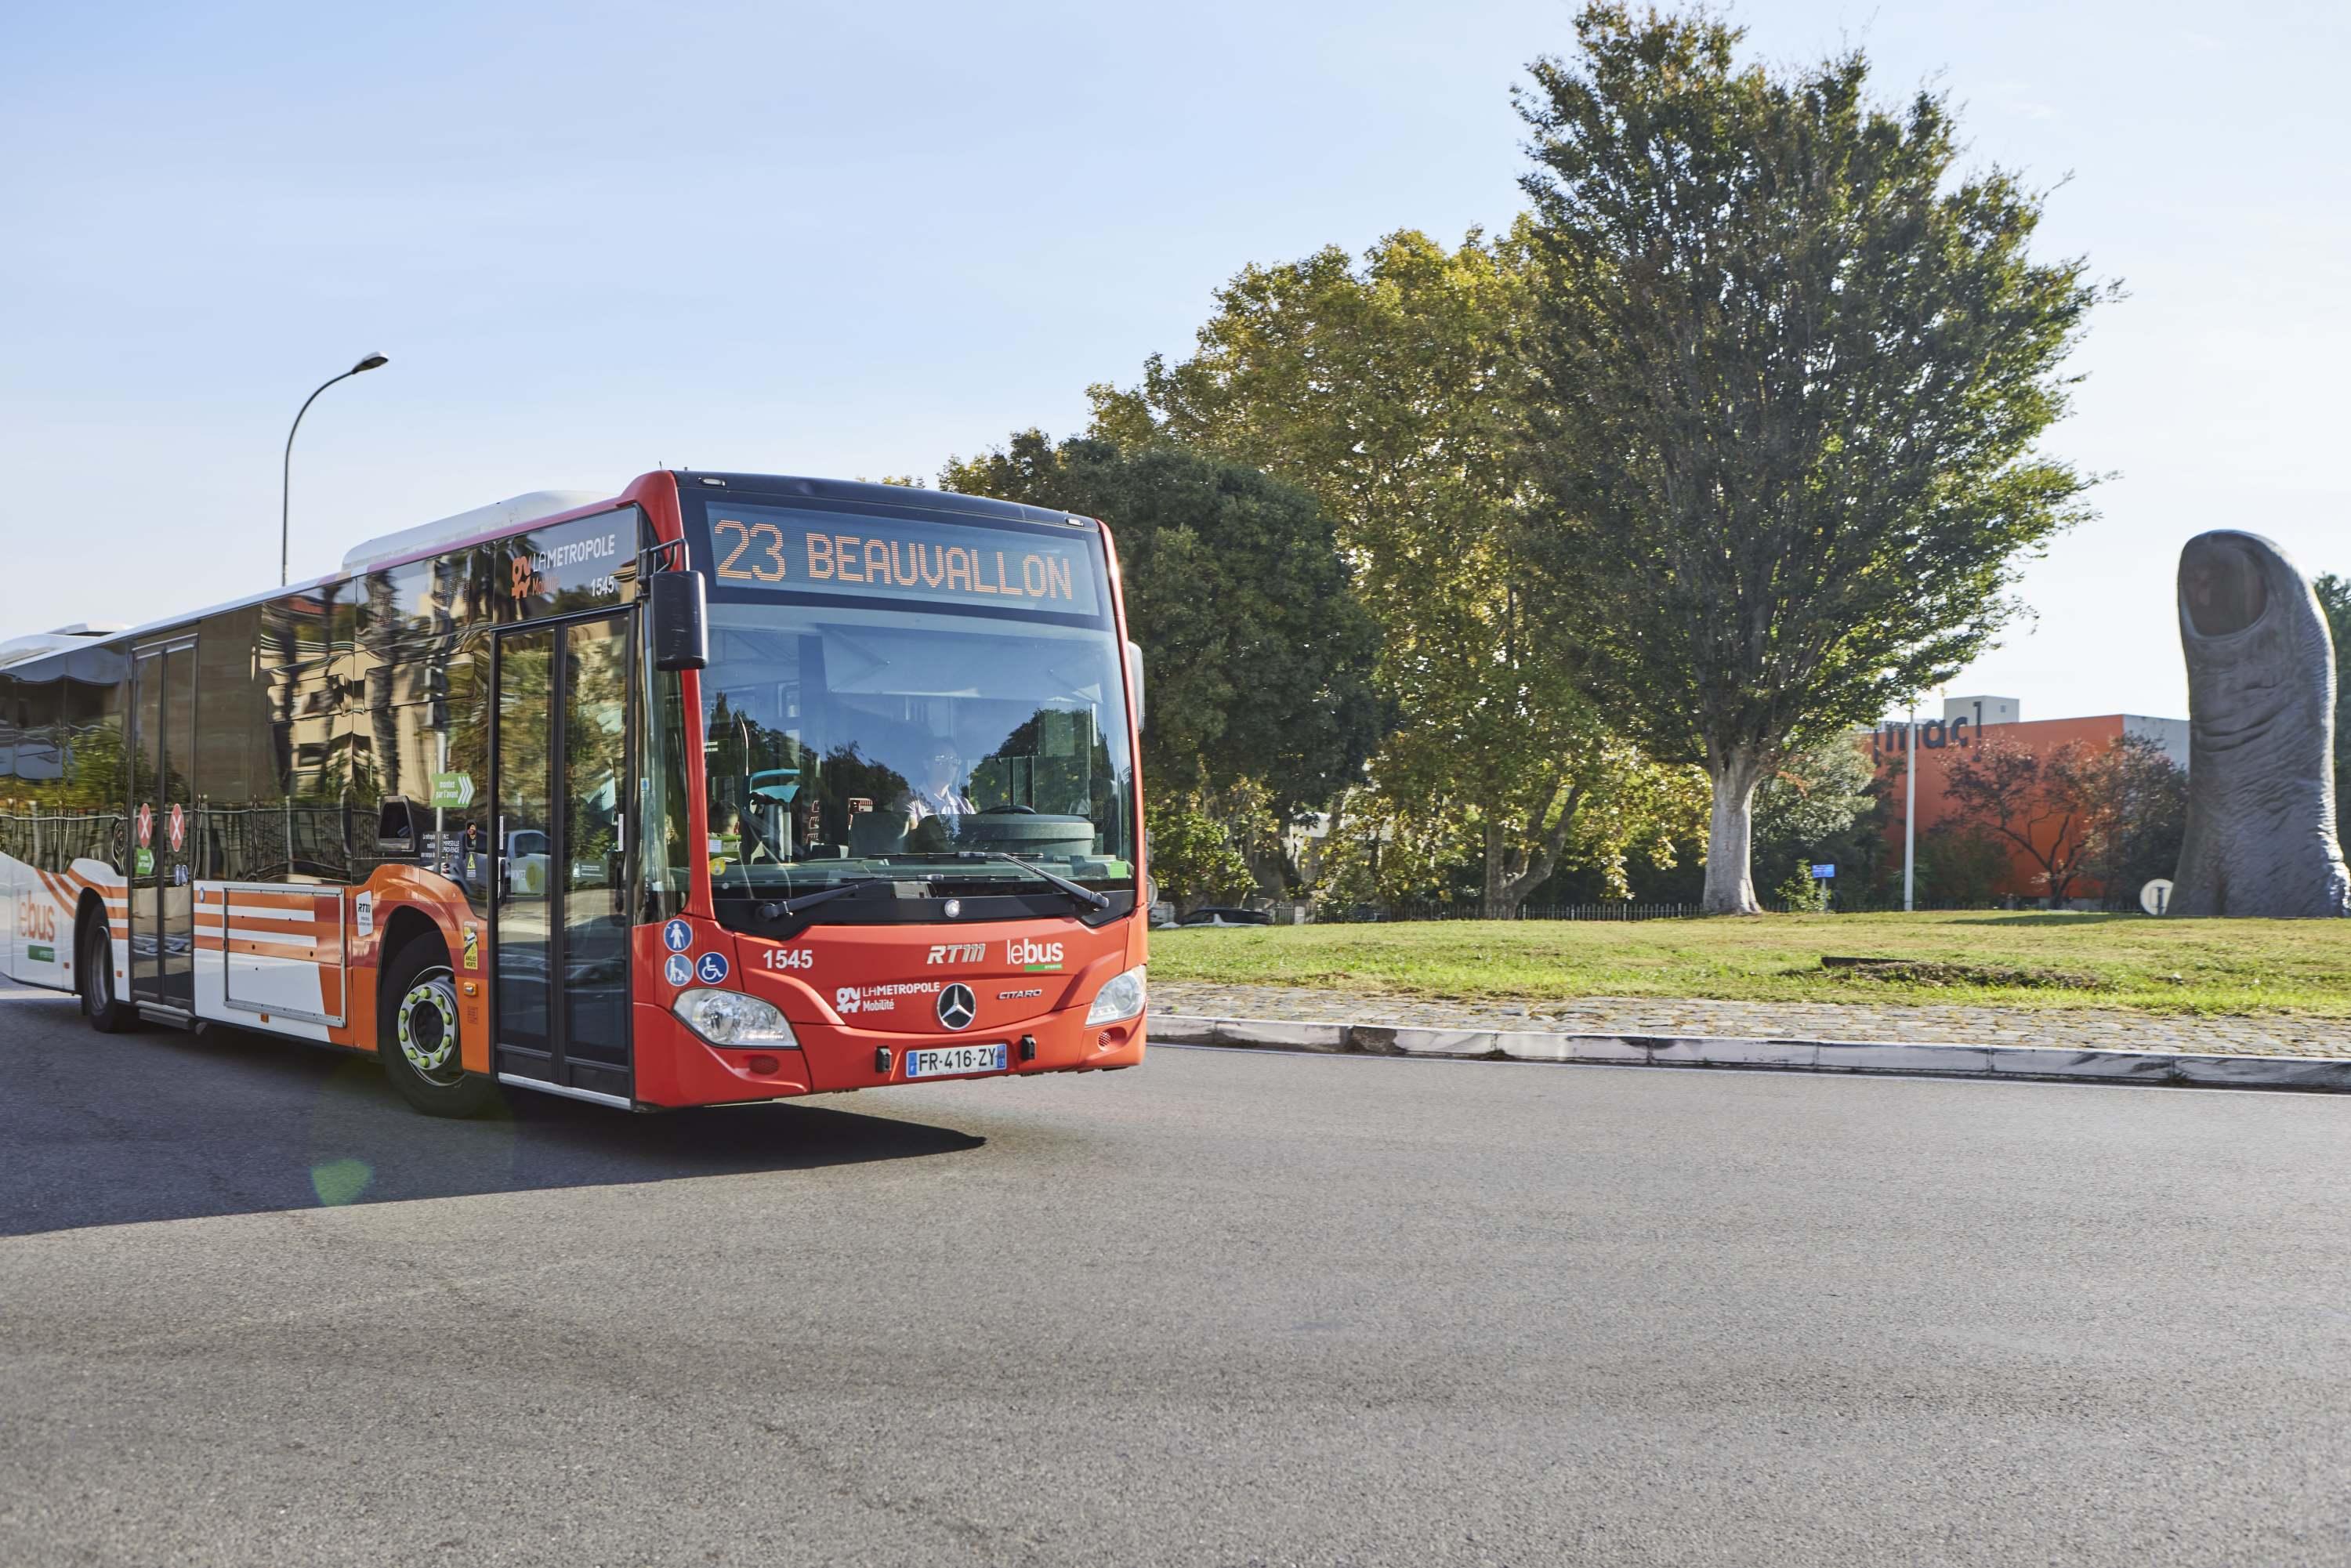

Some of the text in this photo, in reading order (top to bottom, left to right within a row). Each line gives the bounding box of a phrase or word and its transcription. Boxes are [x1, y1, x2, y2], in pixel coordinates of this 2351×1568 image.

[714, 520, 1073, 599] 23 BEAUVALLON
[591, 575, 614, 596] 1545
[358, 903, 371, 913] RTM
[763, 949, 813, 969] 1545
[926, 943, 986, 965] RTM
[1006, 939, 1063, 965] lebus
[997, 989, 1042, 1000] CITARO
[863, 998, 895, 1012] Mobilité
